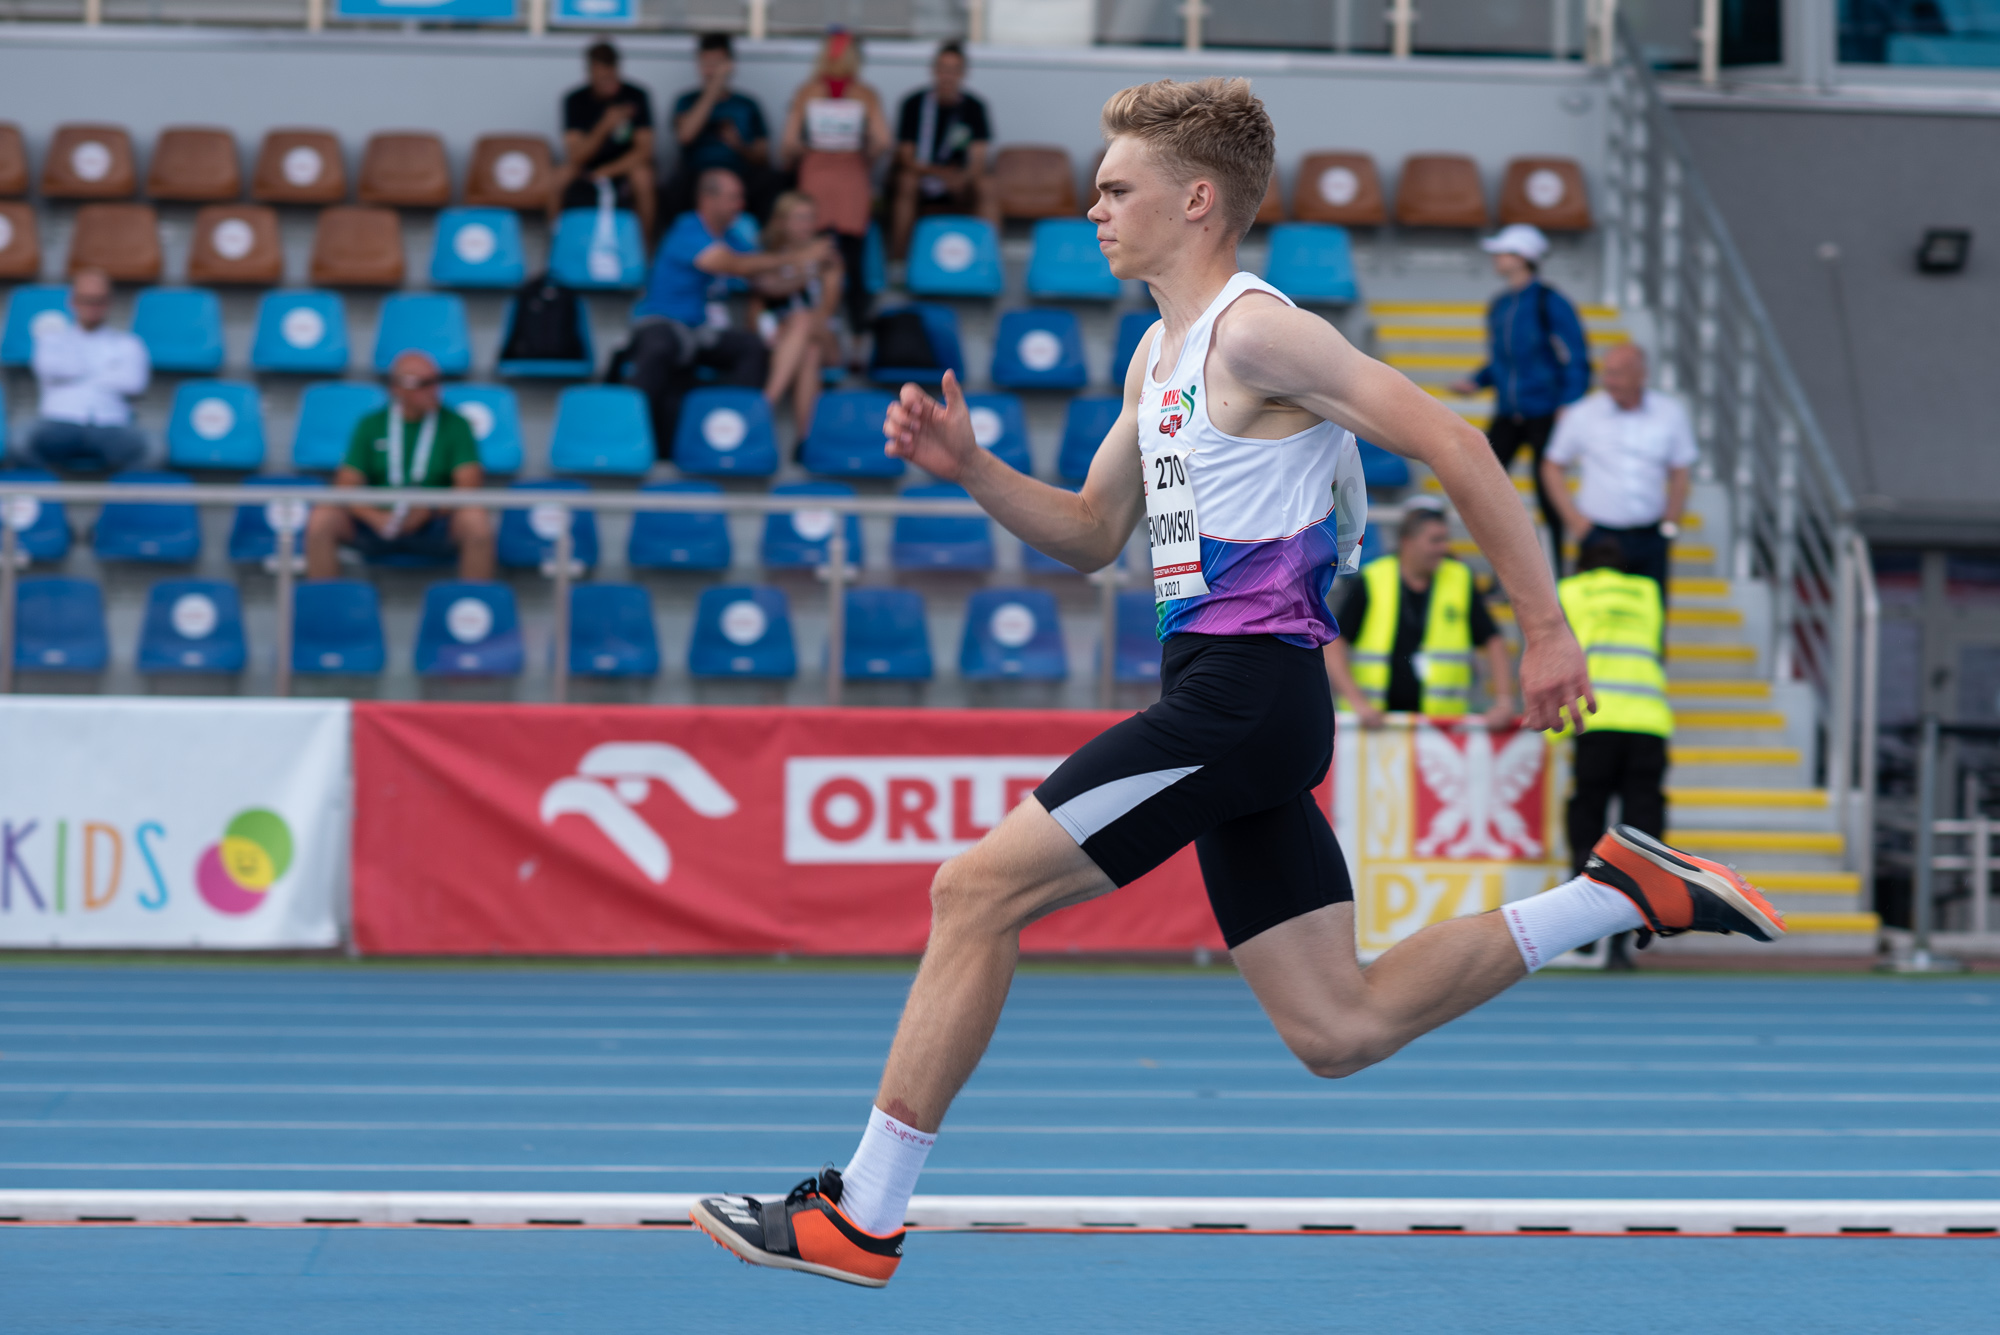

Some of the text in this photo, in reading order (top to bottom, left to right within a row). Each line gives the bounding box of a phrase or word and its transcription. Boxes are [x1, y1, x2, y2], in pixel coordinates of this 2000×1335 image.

[1161, 389, 1181, 407] MKS
[1155, 454, 1186, 490] 270
[1164, 580, 1181, 597] 2021
[0, 818, 169, 913] KIDS
